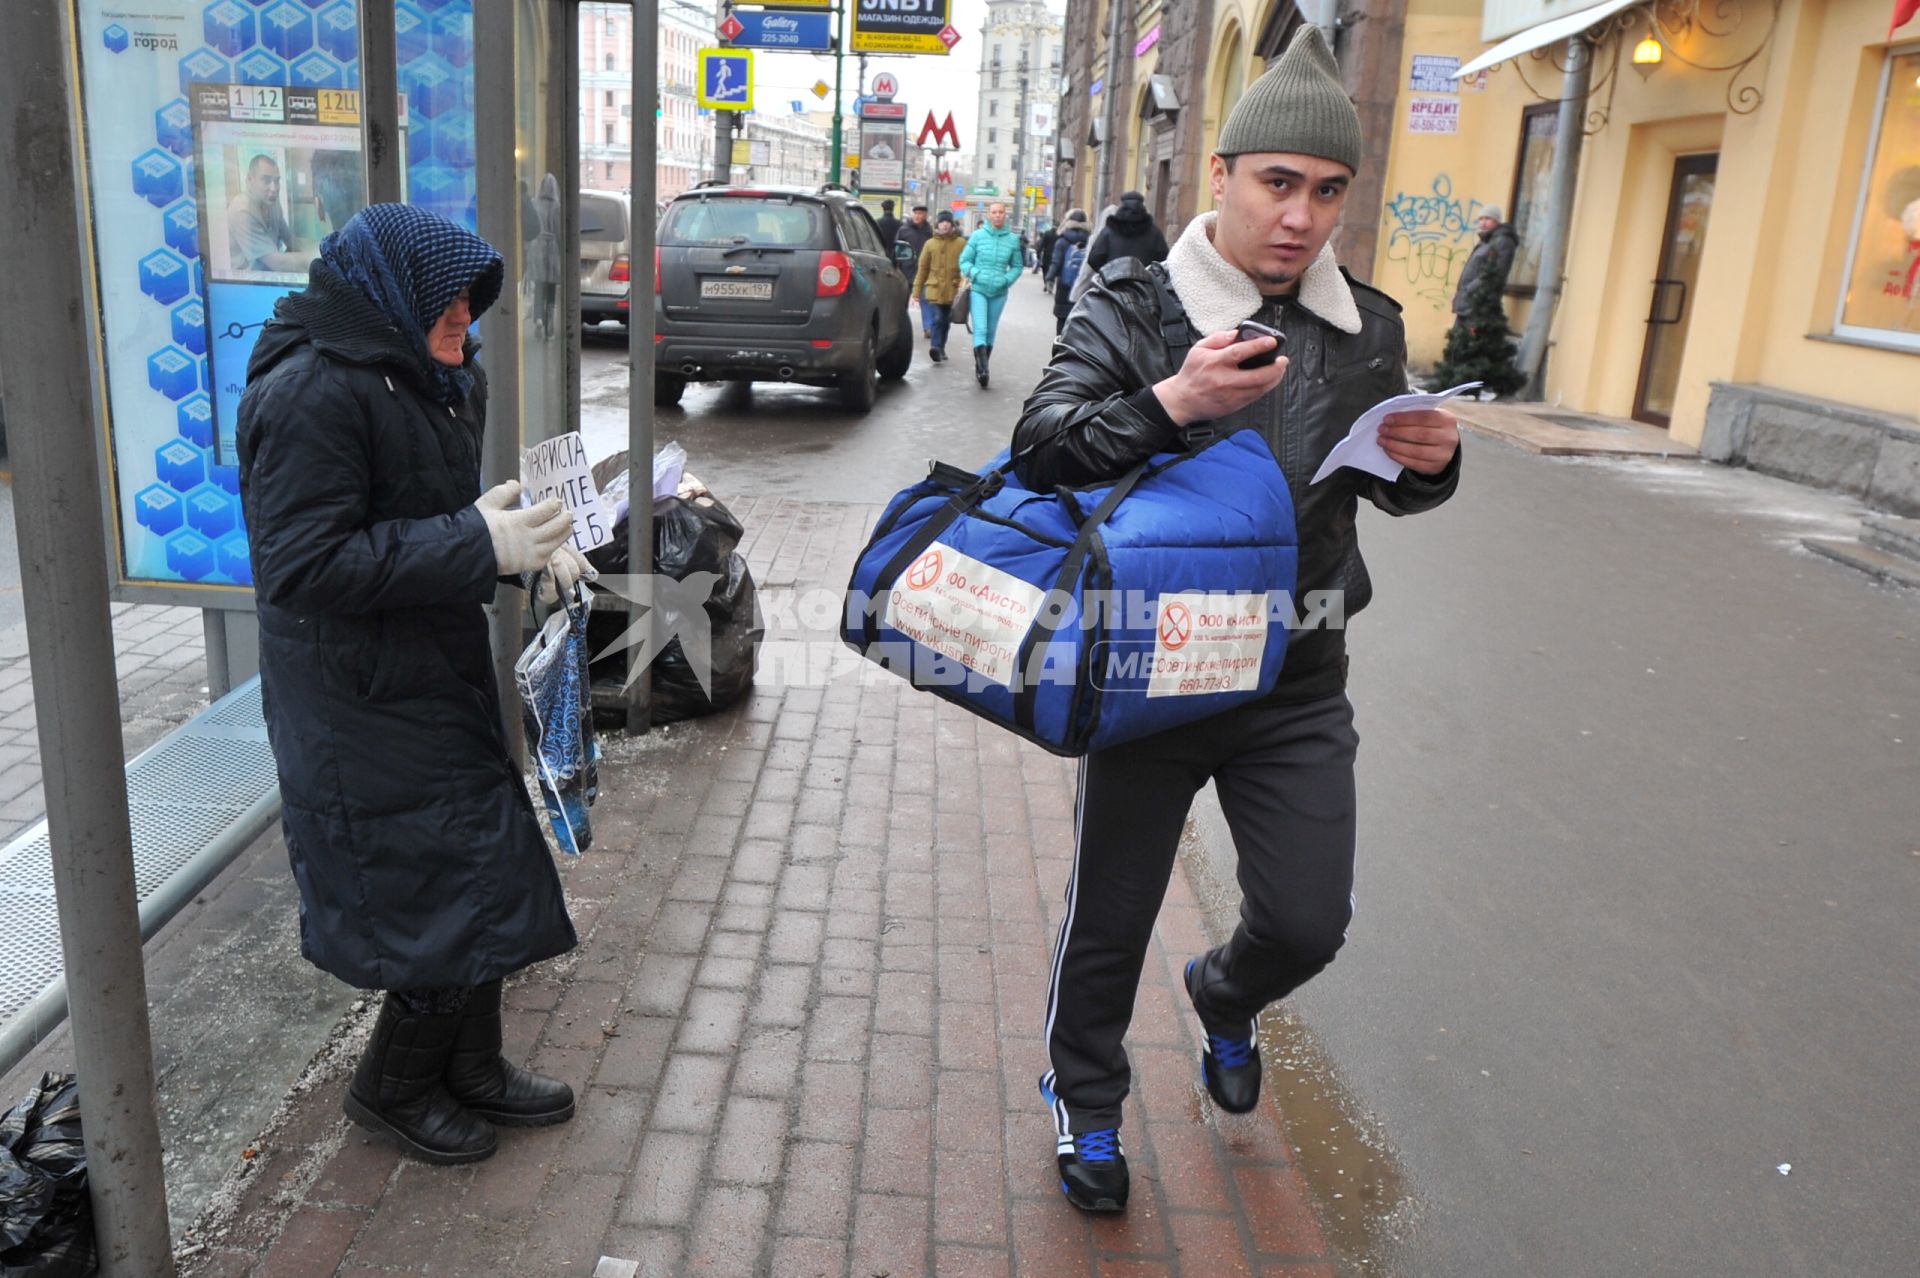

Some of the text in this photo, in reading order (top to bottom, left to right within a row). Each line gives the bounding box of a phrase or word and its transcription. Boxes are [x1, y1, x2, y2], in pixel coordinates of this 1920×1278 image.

[858, 13, 945, 25] МАГАЗИН ОДЕЖДЫ
[134, 37, 178, 51] город
[235, 88, 244, 105] 1
[258, 89, 278, 107] 12
[1411, 102, 1458, 115] КРЕДИТ
[752, 283, 769, 293] 197
[969, 584, 1028, 614] «Аист»
[1198, 614, 1223, 628] ООО
[963, 631, 1013, 663] пироги
[1156, 656, 1258, 674] Осетинские пироги
